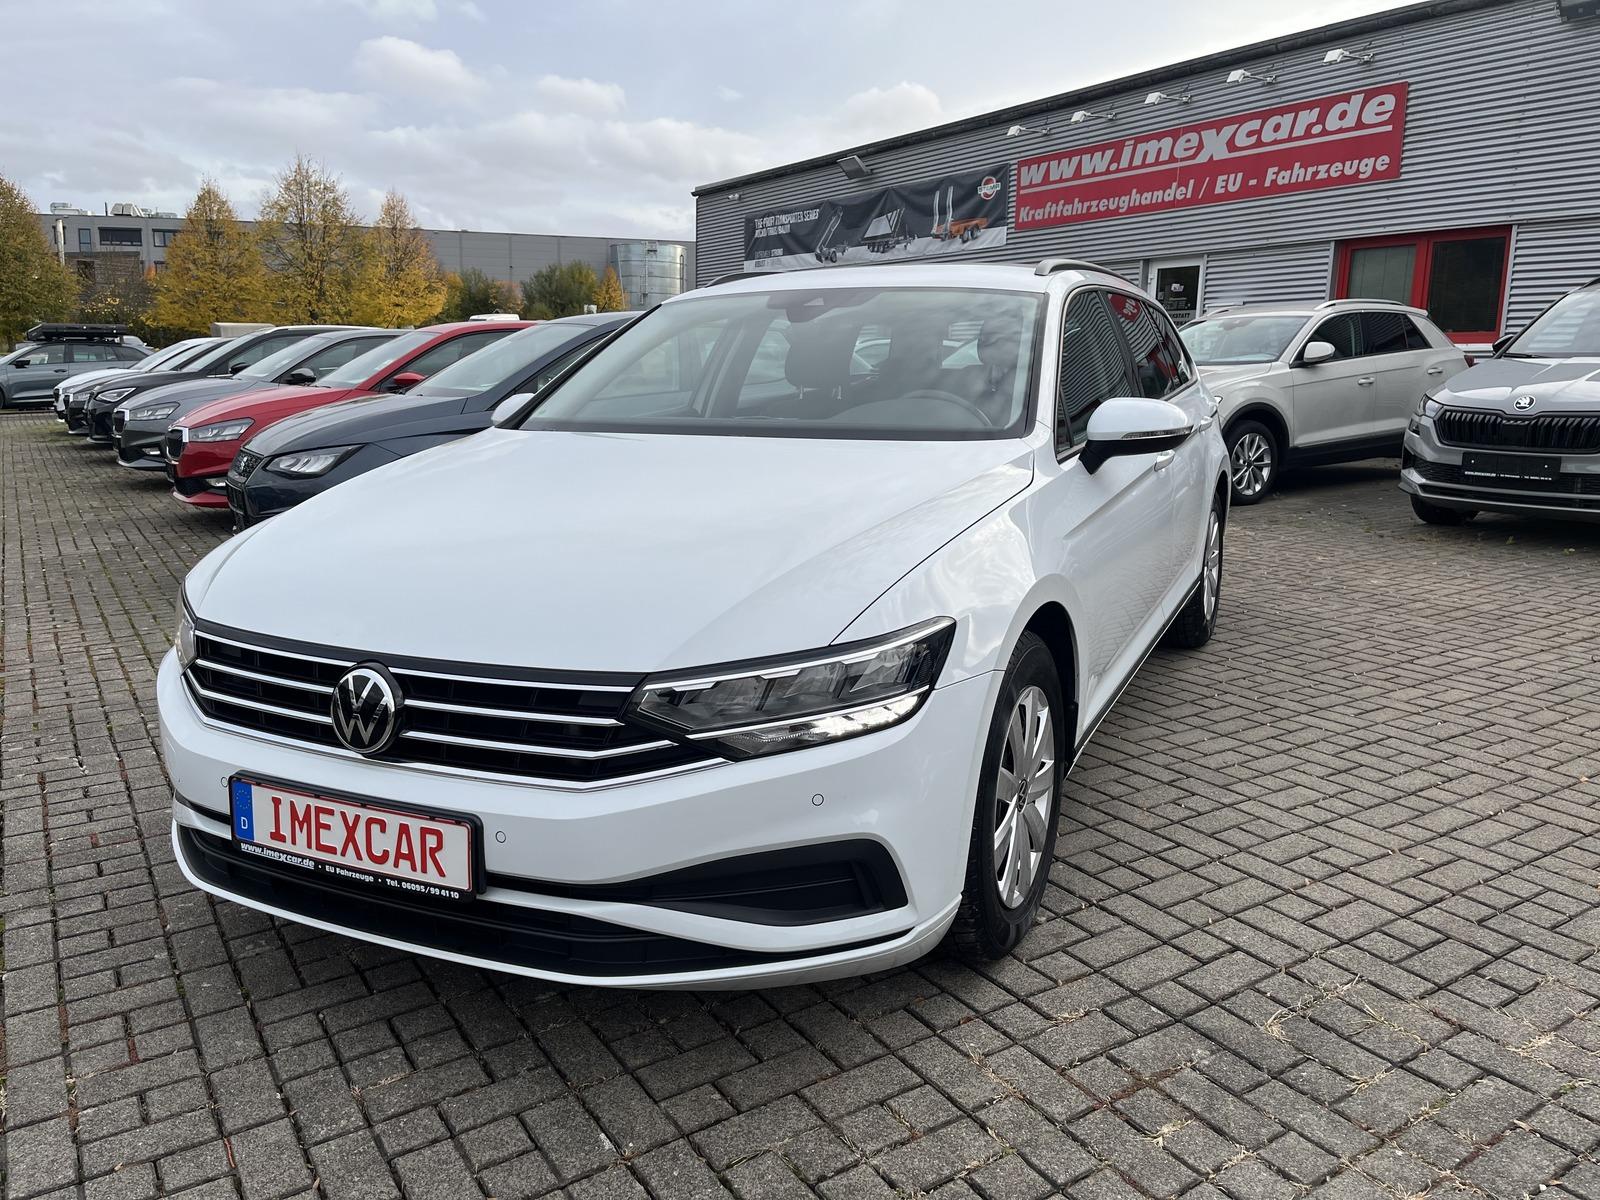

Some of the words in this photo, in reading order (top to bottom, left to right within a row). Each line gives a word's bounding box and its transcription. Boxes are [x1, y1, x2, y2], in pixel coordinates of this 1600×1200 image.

[1019, 93, 1397, 188] www.imexcar.de
[803, 208, 820, 221] SERIES
[1018, 177, 1195, 223] Kraftfahrzeughandel
[1198, 177, 1210, 199] /
[1214, 172, 1243, 194] EU
[1264, 154, 1391, 188] Fahrzeuge
[240, 816, 248, 830] D
[269, 796, 446, 878] IMEXCAR
[240, 842, 315, 868] www.imexcar.de
[325, 865, 335, 873] EU
[336, 867, 374, 883] Fahrzeuge
[386, 878, 400, 888] Tel.
